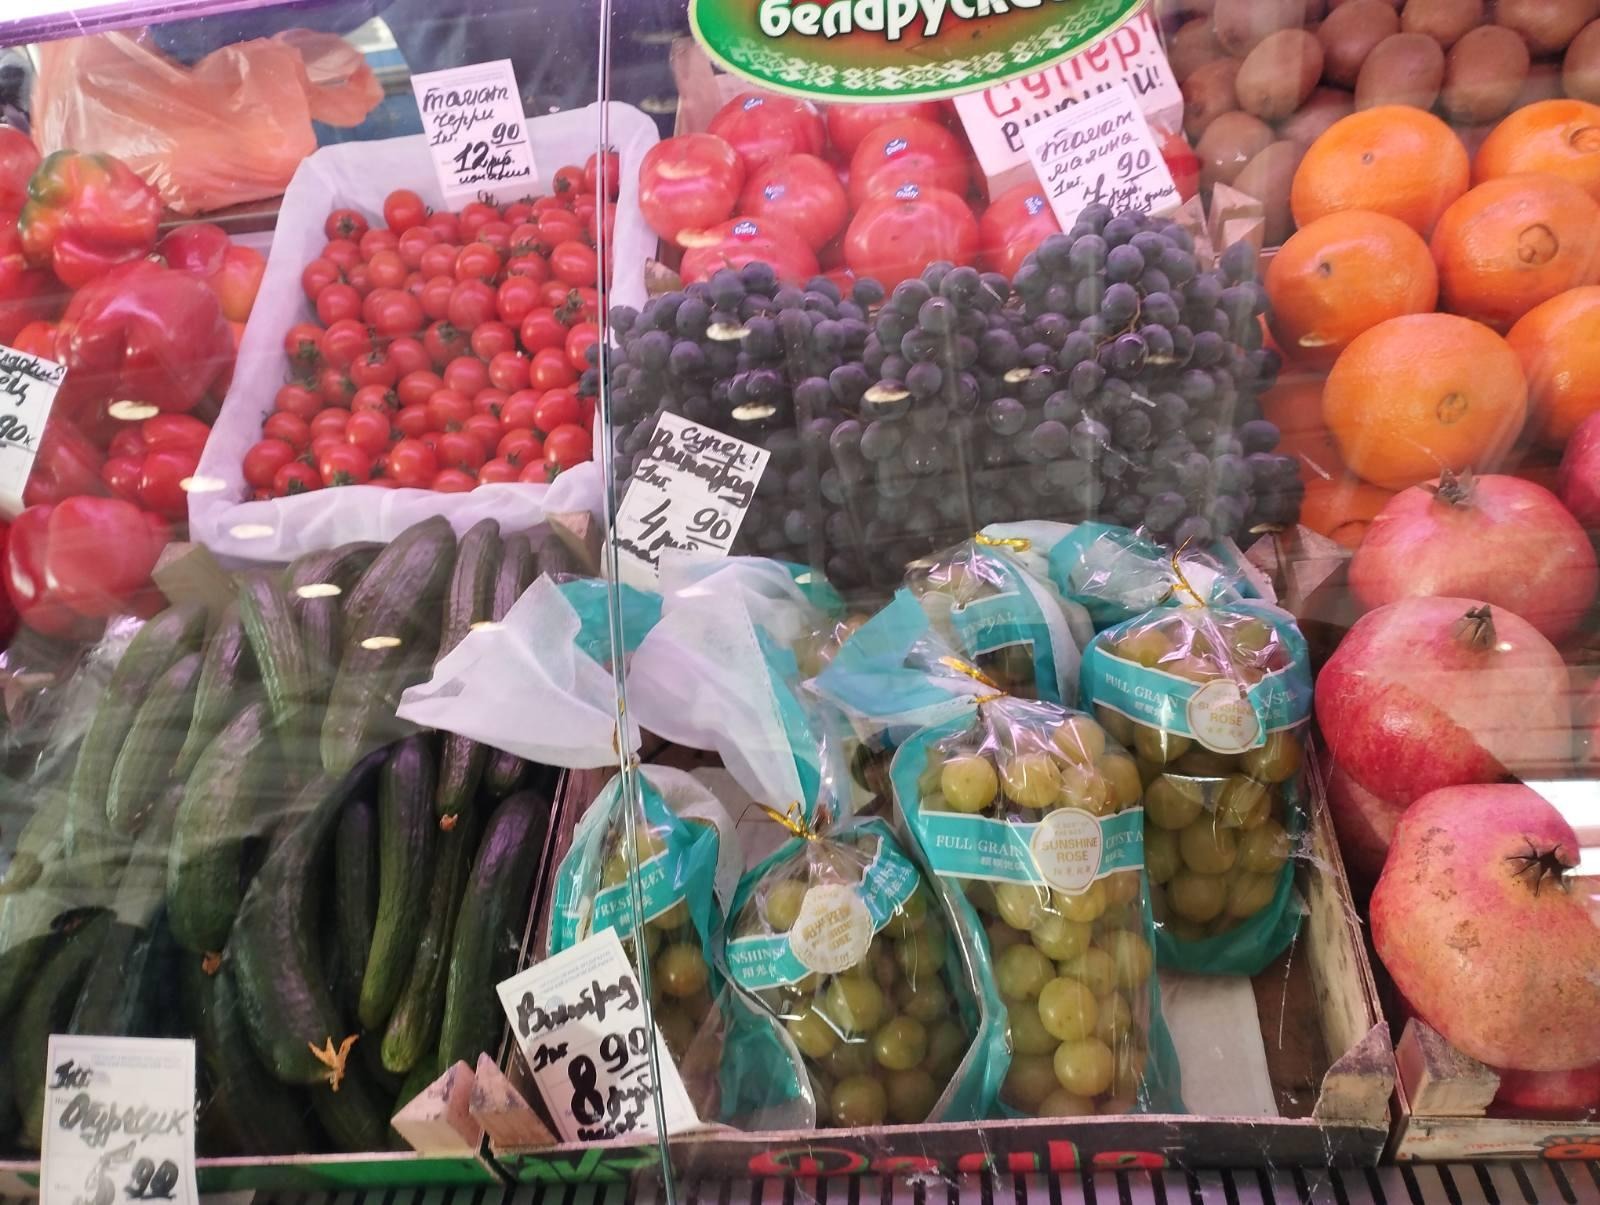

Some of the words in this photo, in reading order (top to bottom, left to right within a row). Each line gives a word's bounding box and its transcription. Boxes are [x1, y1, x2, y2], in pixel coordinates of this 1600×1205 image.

[490, 122, 521, 144] 90
[454, 141, 490, 173] 12
[1117, 149, 1152, 179] 90
[686, 508, 732, 540] 90
[1210, 712, 1243, 727] ROSE
[936, 834, 973, 850] FULL
[978, 839, 1024, 858] GRAIN
[1041, 836, 1099, 852] SUNSHINE
[1056, 851, 1089, 864] ROSE
[600, 1027, 648, 1073] 90
[567, 1053, 605, 1125] 8
